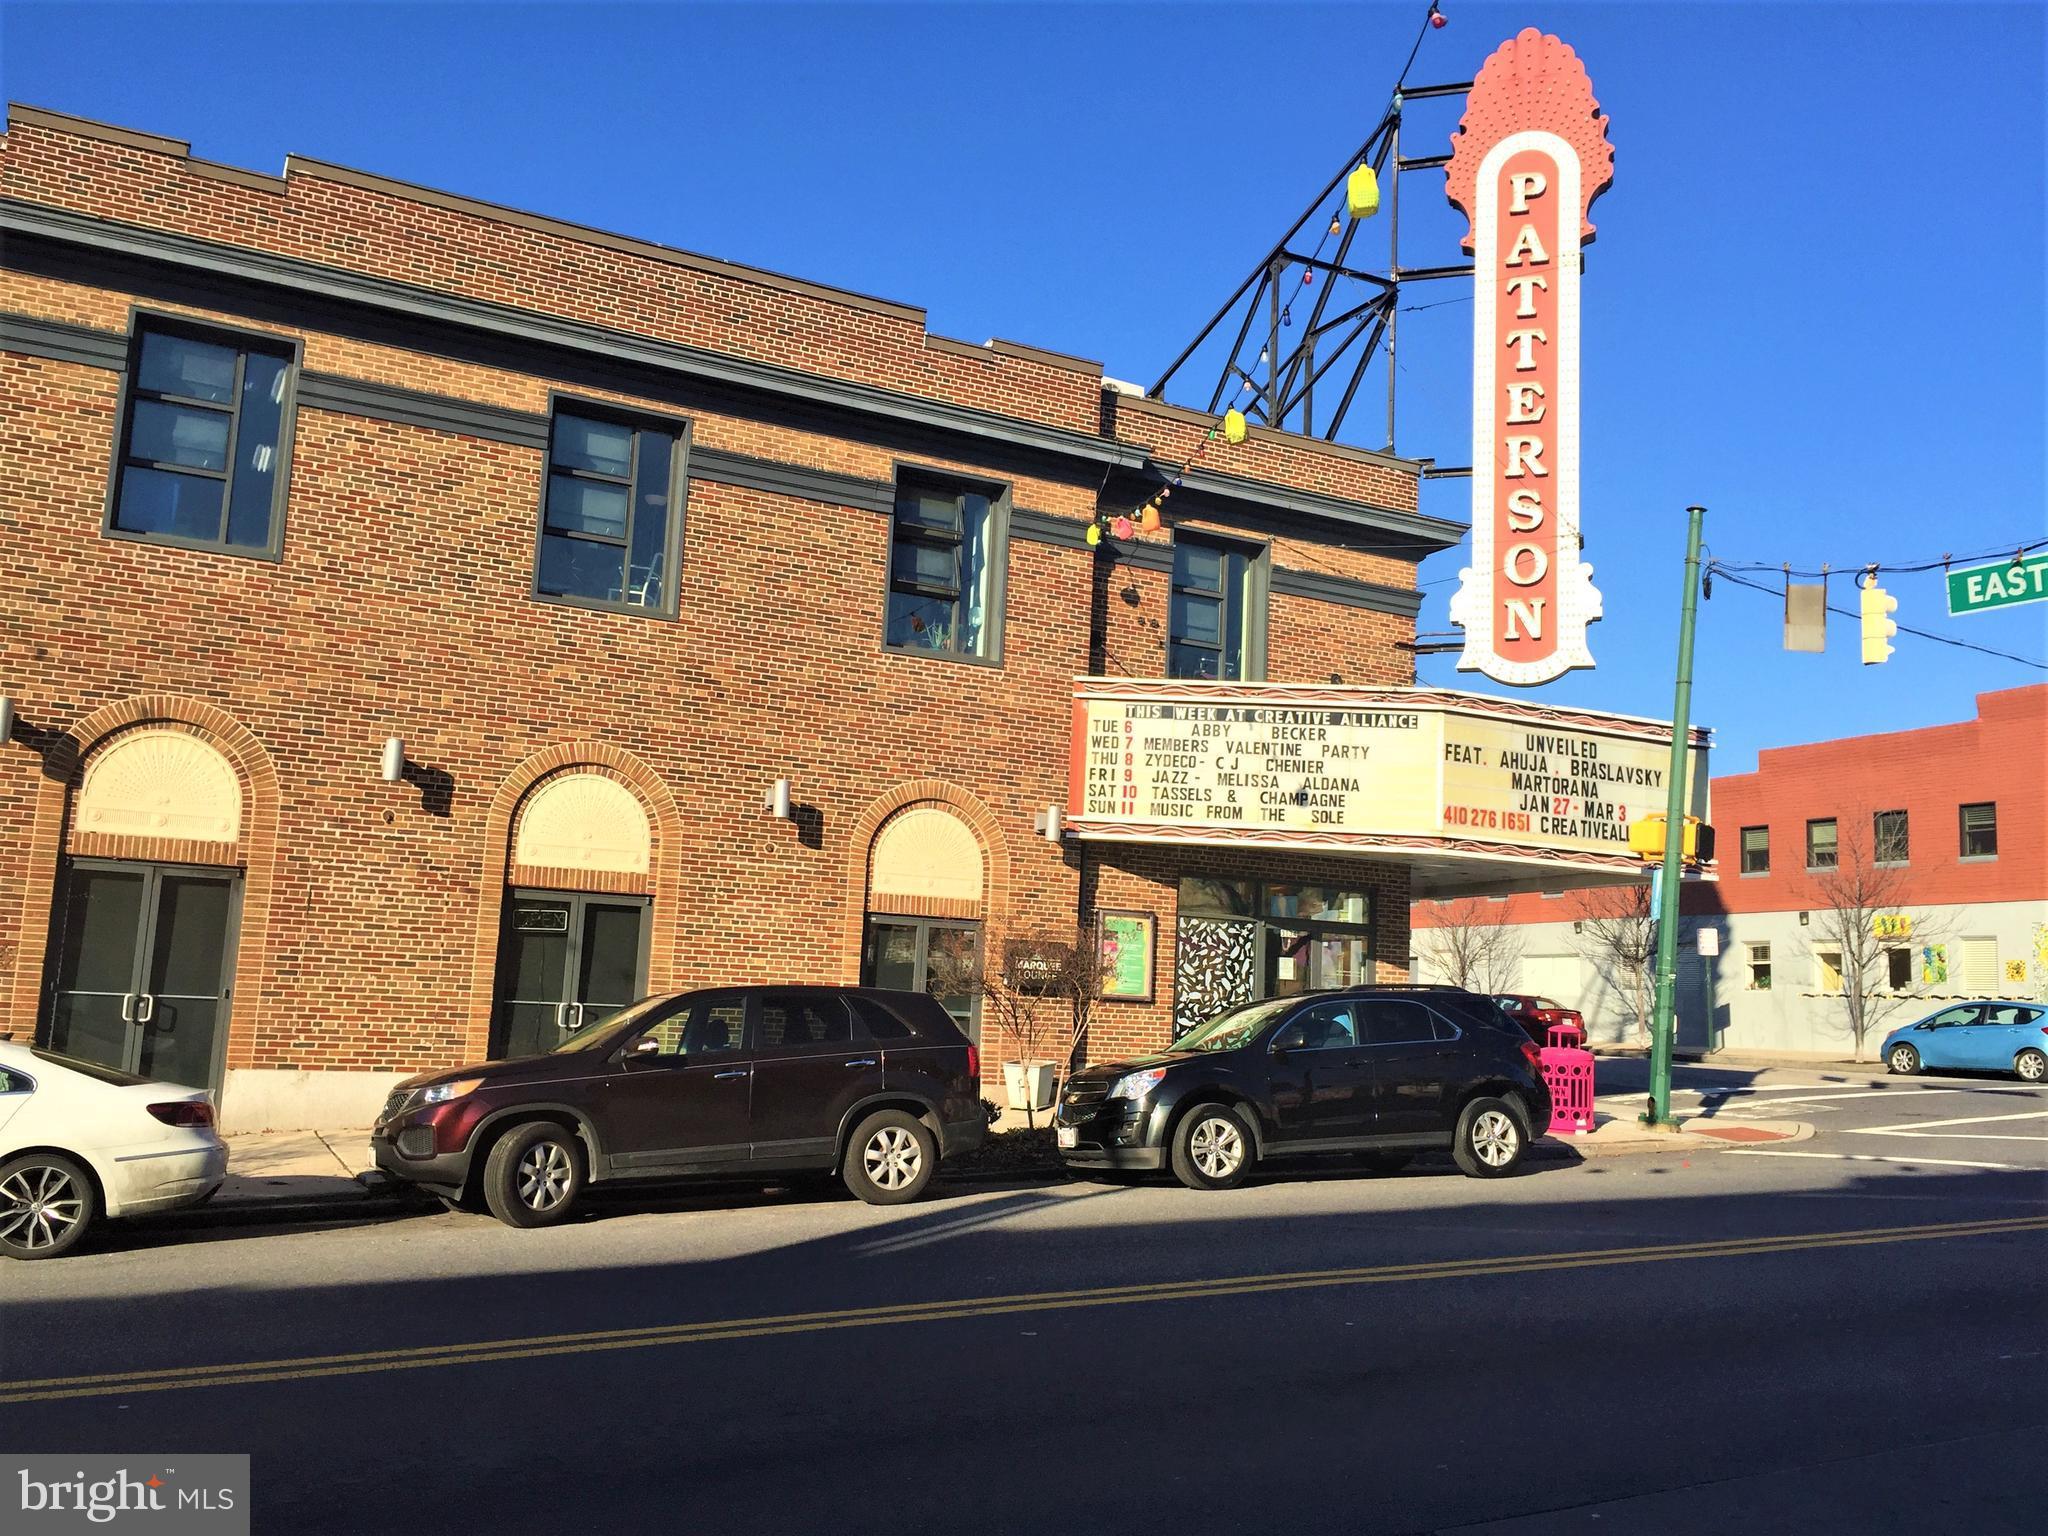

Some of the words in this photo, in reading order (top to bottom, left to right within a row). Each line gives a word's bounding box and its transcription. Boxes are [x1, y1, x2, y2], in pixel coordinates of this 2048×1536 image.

[1503, 171, 1551, 641] PATTERSON
[1967, 562, 2048, 604] EAST
[1093, 719, 1118, 733] TUE
[1124, 720, 1133, 734] 6
[1191, 723, 1231, 737] ABBY
[1272, 726, 1327, 741] BECKER
[1126, 705, 1161, 718] THIS
[1175, 706, 1217, 720] WEEK
[1225, 709, 1245, 722] AT
[1254, 709, 1331, 725] CREATIVE
[1341, 714, 1418, 729] ALLIANCE
[1091, 735, 1119, 749] WED
[1125, 736, 1133, 750] 7
[1144, 737, 1209, 753] MEMBERS
[1226, 740, 1302, 757] VALENTINE
[1322, 744, 1370, 760] PARTY
[1526, 734, 1597, 760] UNVEILED
[1091, 752, 1119, 765] THU
[1125, 752, 1133, 766] 8
[1266, 758, 1324, 774] CHENIER
[1445, 743, 1487, 766] FEAT.
[1500, 750, 1548, 774] AHUJA
[1571, 759, 1662, 787] BRASLAVSKY
[1089, 767, 1115, 781] FRI
[1124, 768, 1132, 782] 9
[1217, 772, 1279, 789] MELISSA
[1302, 776, 1360, 792] ALDANA
[1512, 772, 1599, 799] MARTORANA
[1088, 783, 1117, 798] SAT
[1122, 785, 1137, 799] 10
[1152, 786, 1212, 802] TASSELS
[1227, 789, 1237, 803] &
[1260, 790, 1346, 808] CHAMPAGNE
[1520, 793, 1550, 814] JAN
[1584, 800, 1614, 821] MAR
[1618, 804, 1627, 822] 3
[1088, 799, 1116, 814] SUN
[1121, 801, 1134, 815] 11
[1150, 802, 1194, 817] MUSIC
[1206, 805, 1243, 820] FROM
[1261, 807, 1285, 822] THE
[1311, 810, 1344, 825] SOLE
[1444, 805, 1468, 825] 410
[1471, 808, 1497, 829] 276
[1502, 811, 1530, 833] 1651
